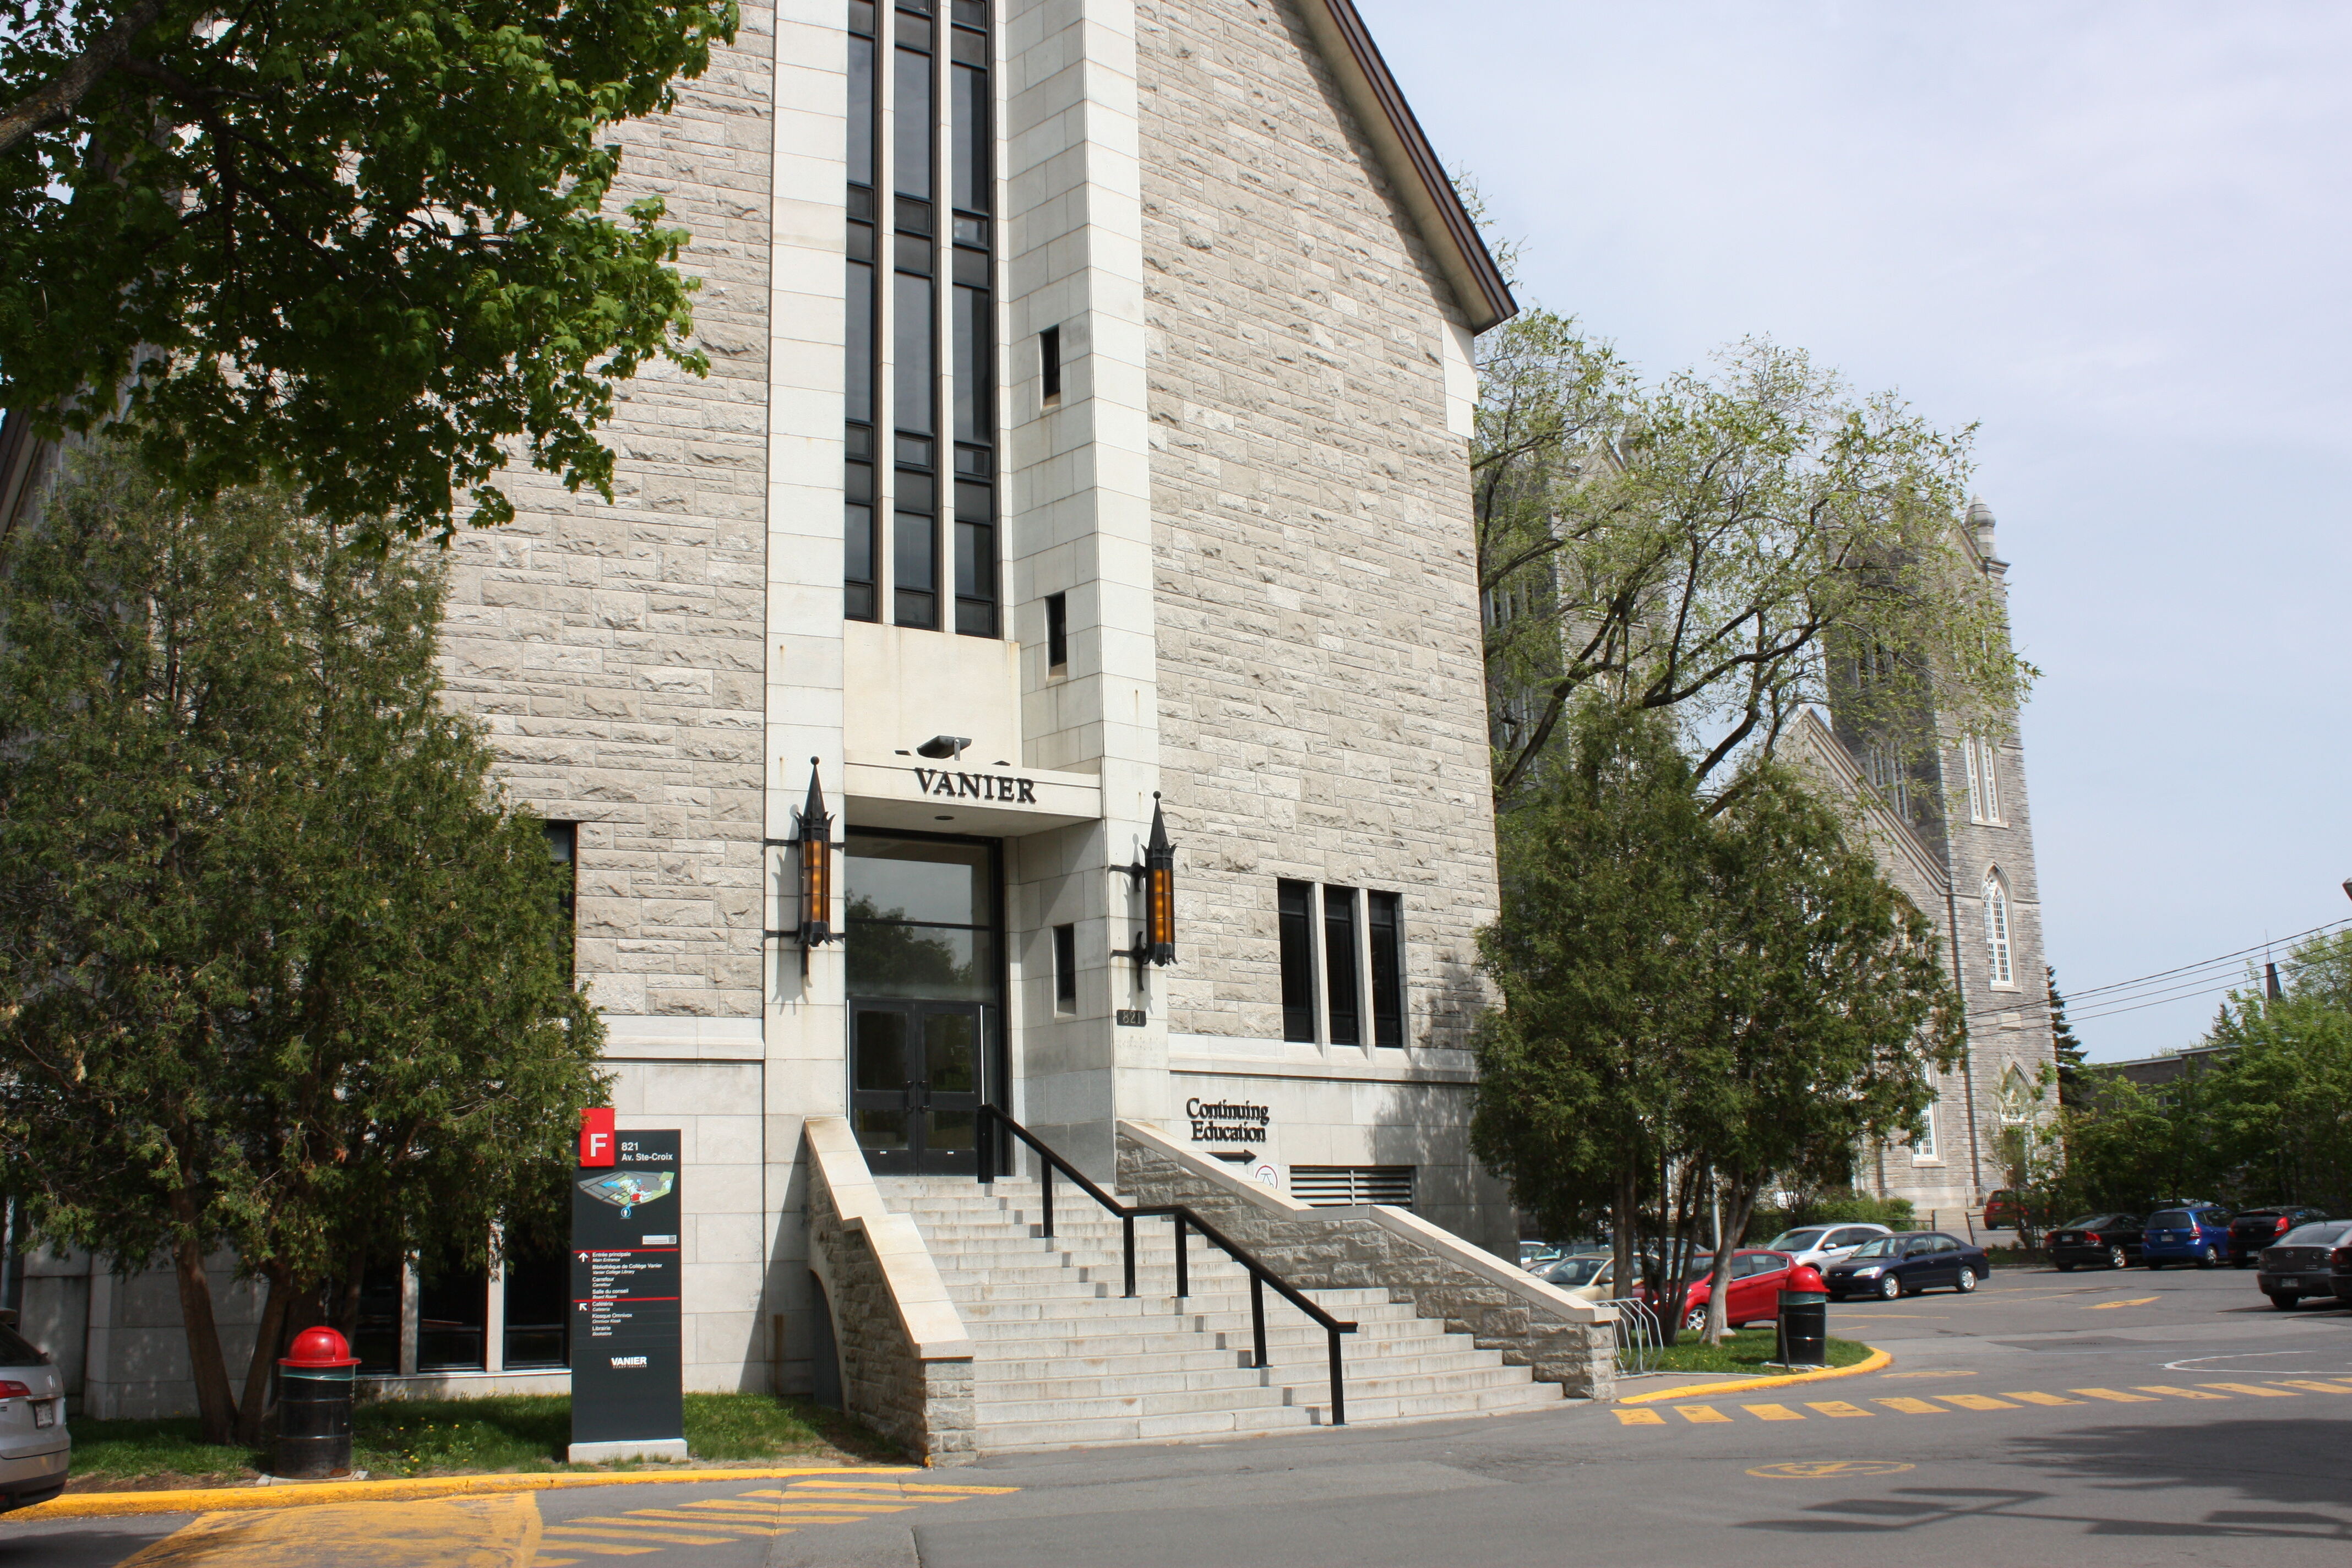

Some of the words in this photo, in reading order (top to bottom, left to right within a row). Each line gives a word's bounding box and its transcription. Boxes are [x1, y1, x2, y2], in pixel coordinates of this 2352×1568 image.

[914, 767, 1036, 803] VANIER
[1123, 1011, 1141, 1024] 821
[1186, 1098, 1270, 1125] Continuing
[1191, 1120, 1266, 1142] Education
[590, 1134, 608, 1157] F
[621, 1142, 639, 1151] 821
[636, 1153, 673, 1161] Ste-Croix
[611, 1357, 647, 1365] VANIER
